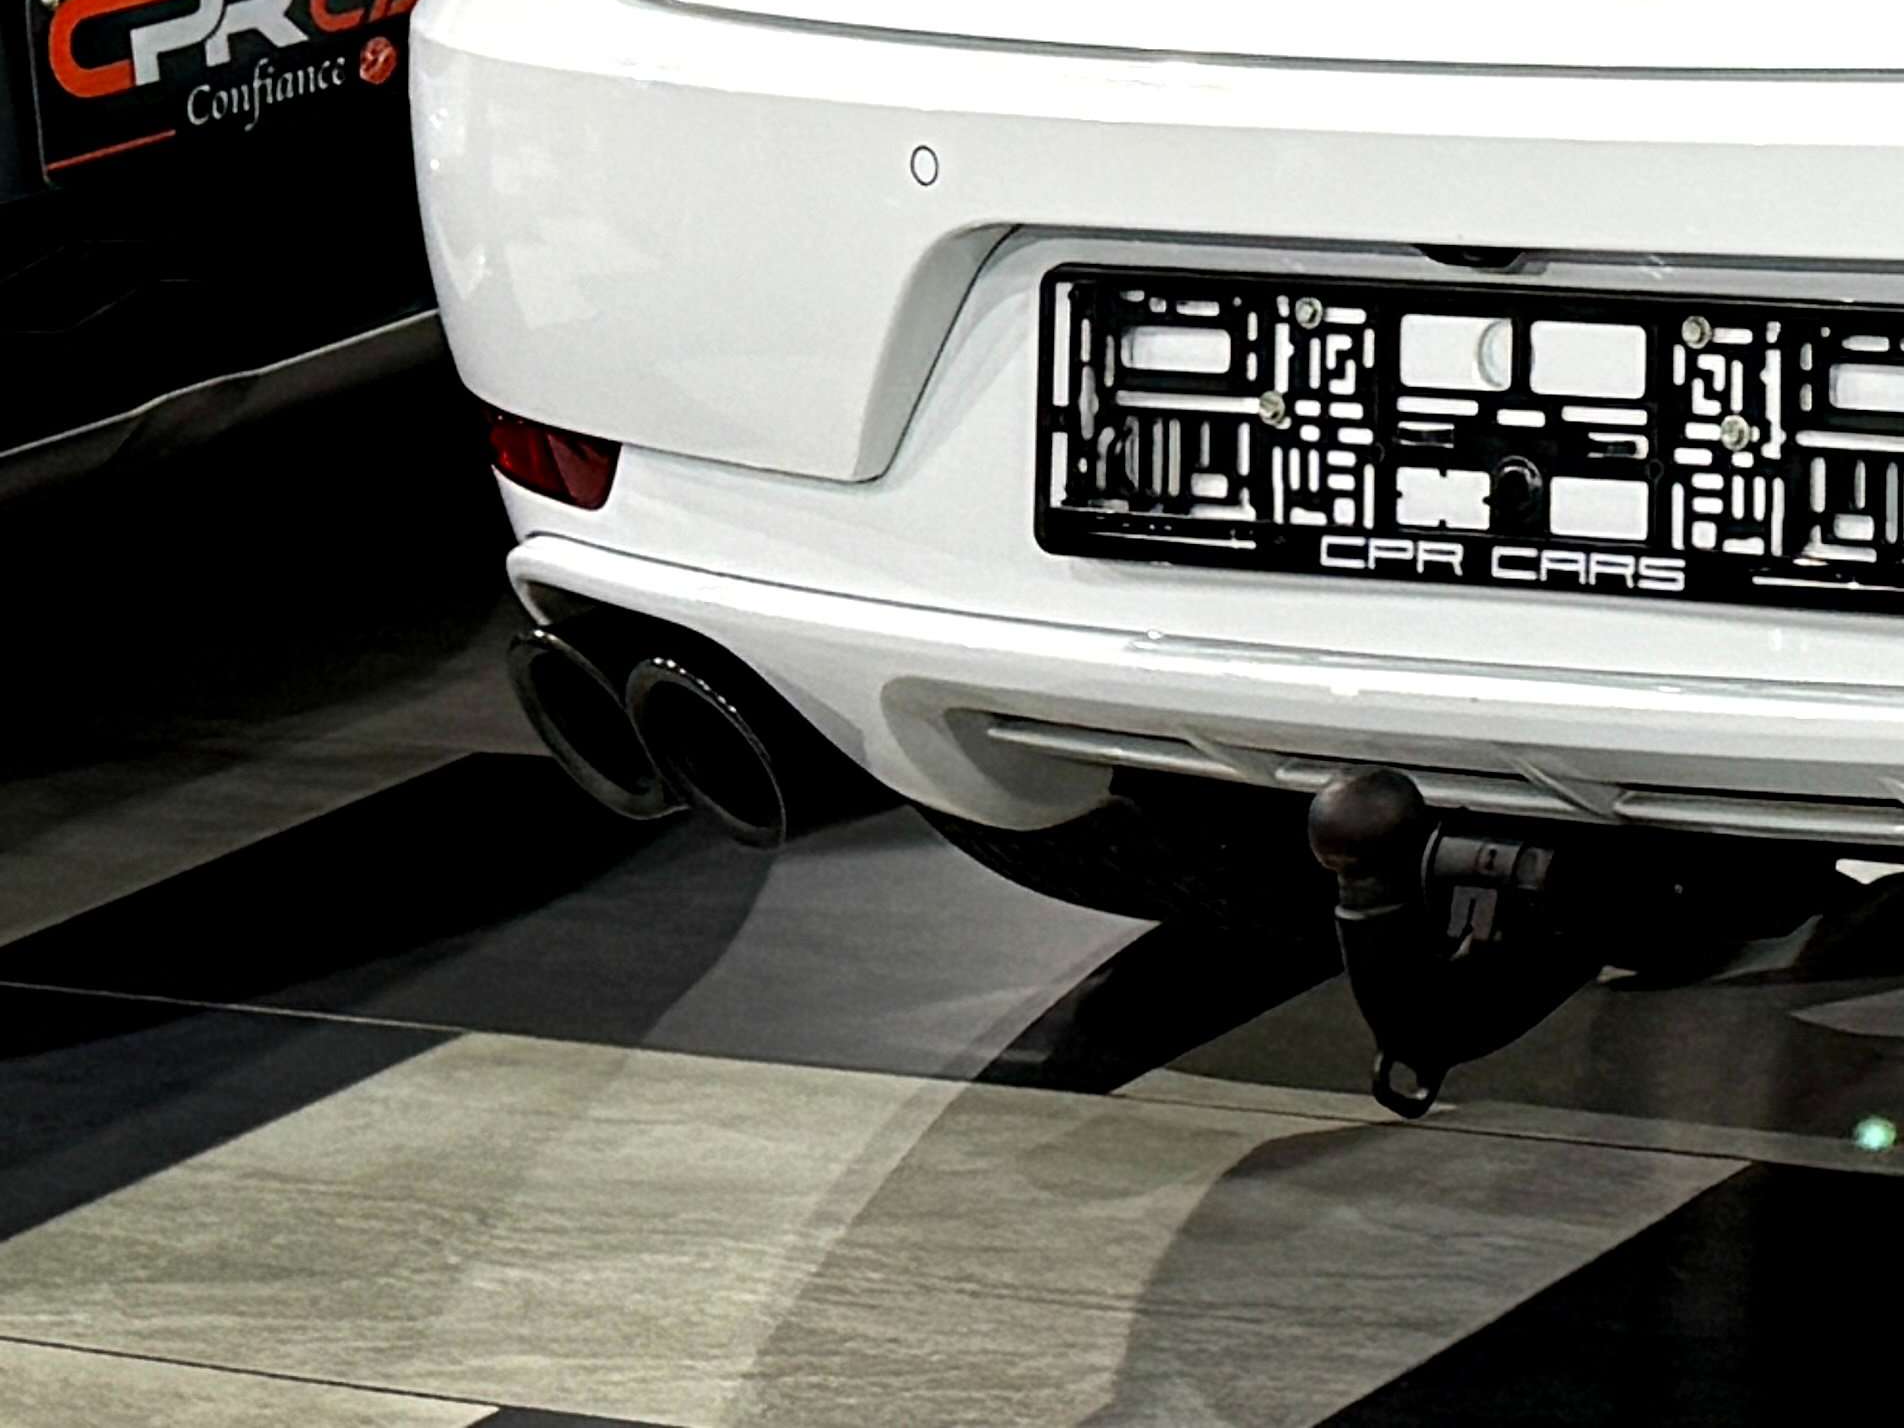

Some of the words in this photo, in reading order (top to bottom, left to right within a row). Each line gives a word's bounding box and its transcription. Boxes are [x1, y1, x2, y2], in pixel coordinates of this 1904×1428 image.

[187, 56, 346, 132] Confiance
[1320, 534, 1464, 577] CPR
[1490, 545, 1686, 592] CARS
